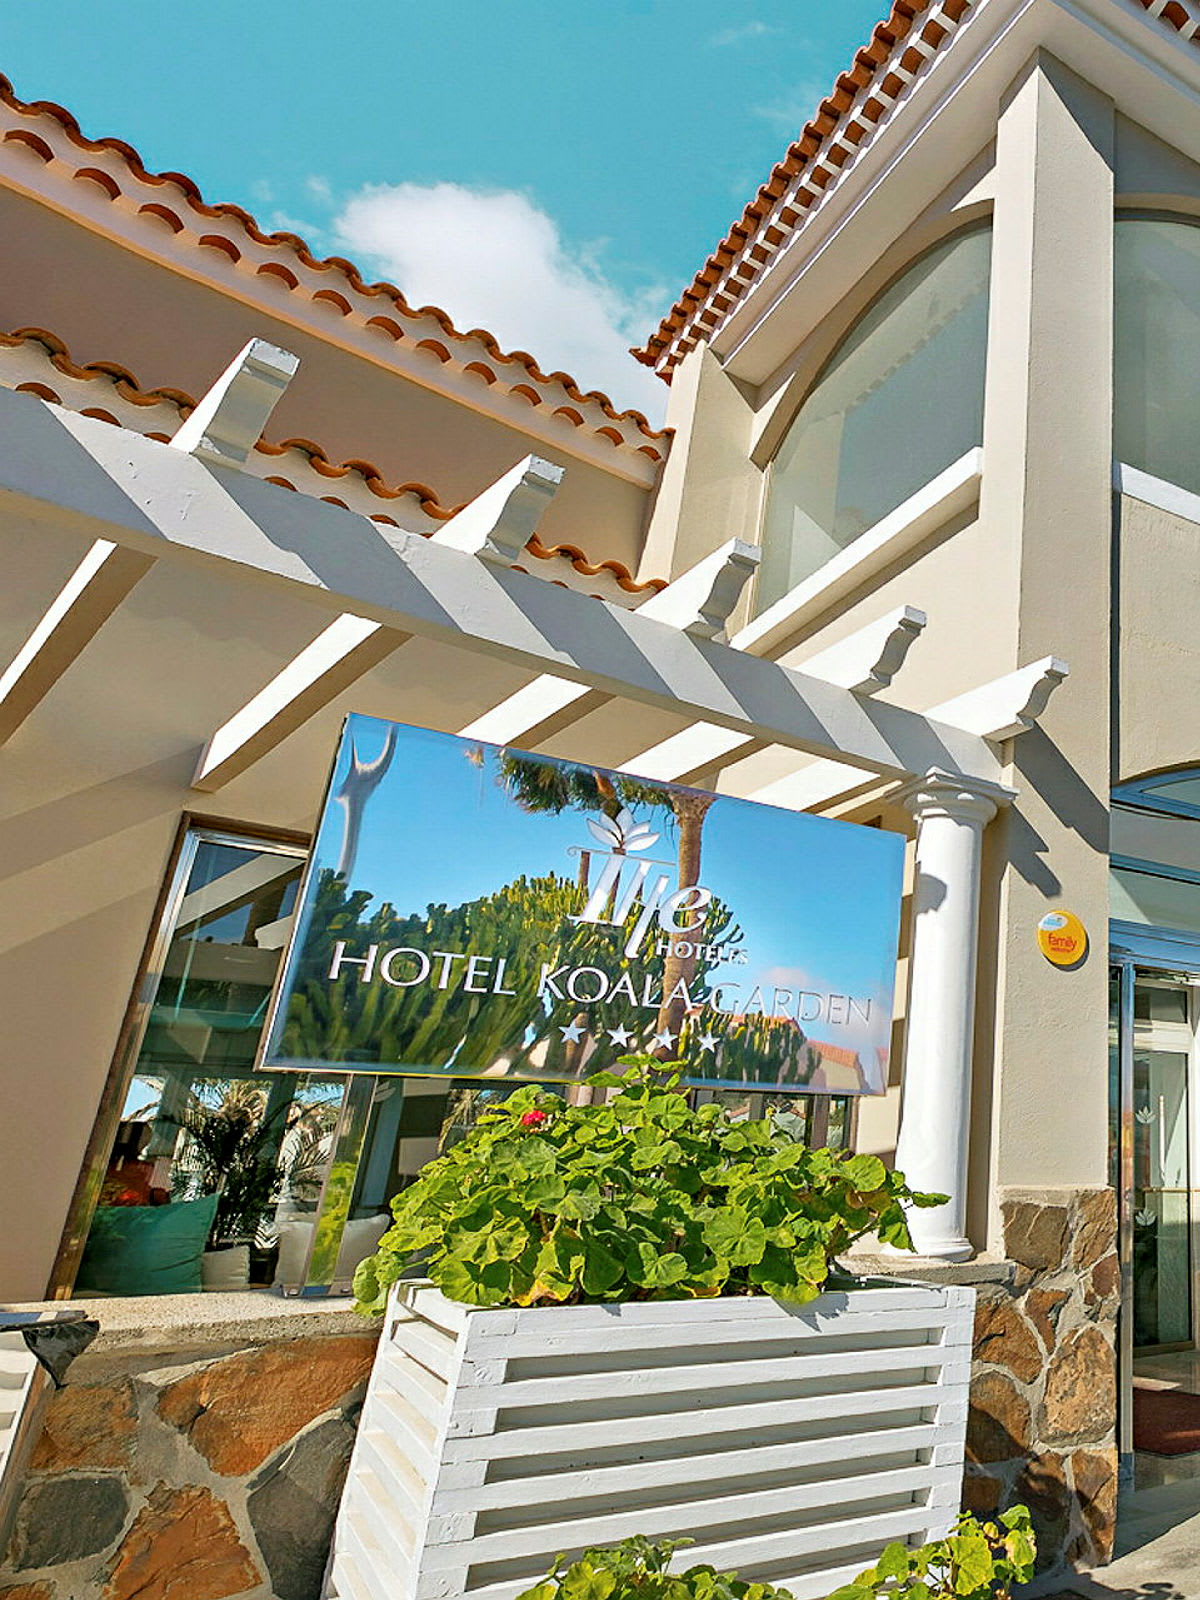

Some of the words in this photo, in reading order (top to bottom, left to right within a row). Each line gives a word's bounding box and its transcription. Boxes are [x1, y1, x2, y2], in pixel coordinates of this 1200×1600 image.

[655, 938, 749, 965] HOTELES
[328, 941, 516, 996] HOTEL
[537, 963, 693, 1012] KOALA
[710, 982, 873, 1028] GARDEN
